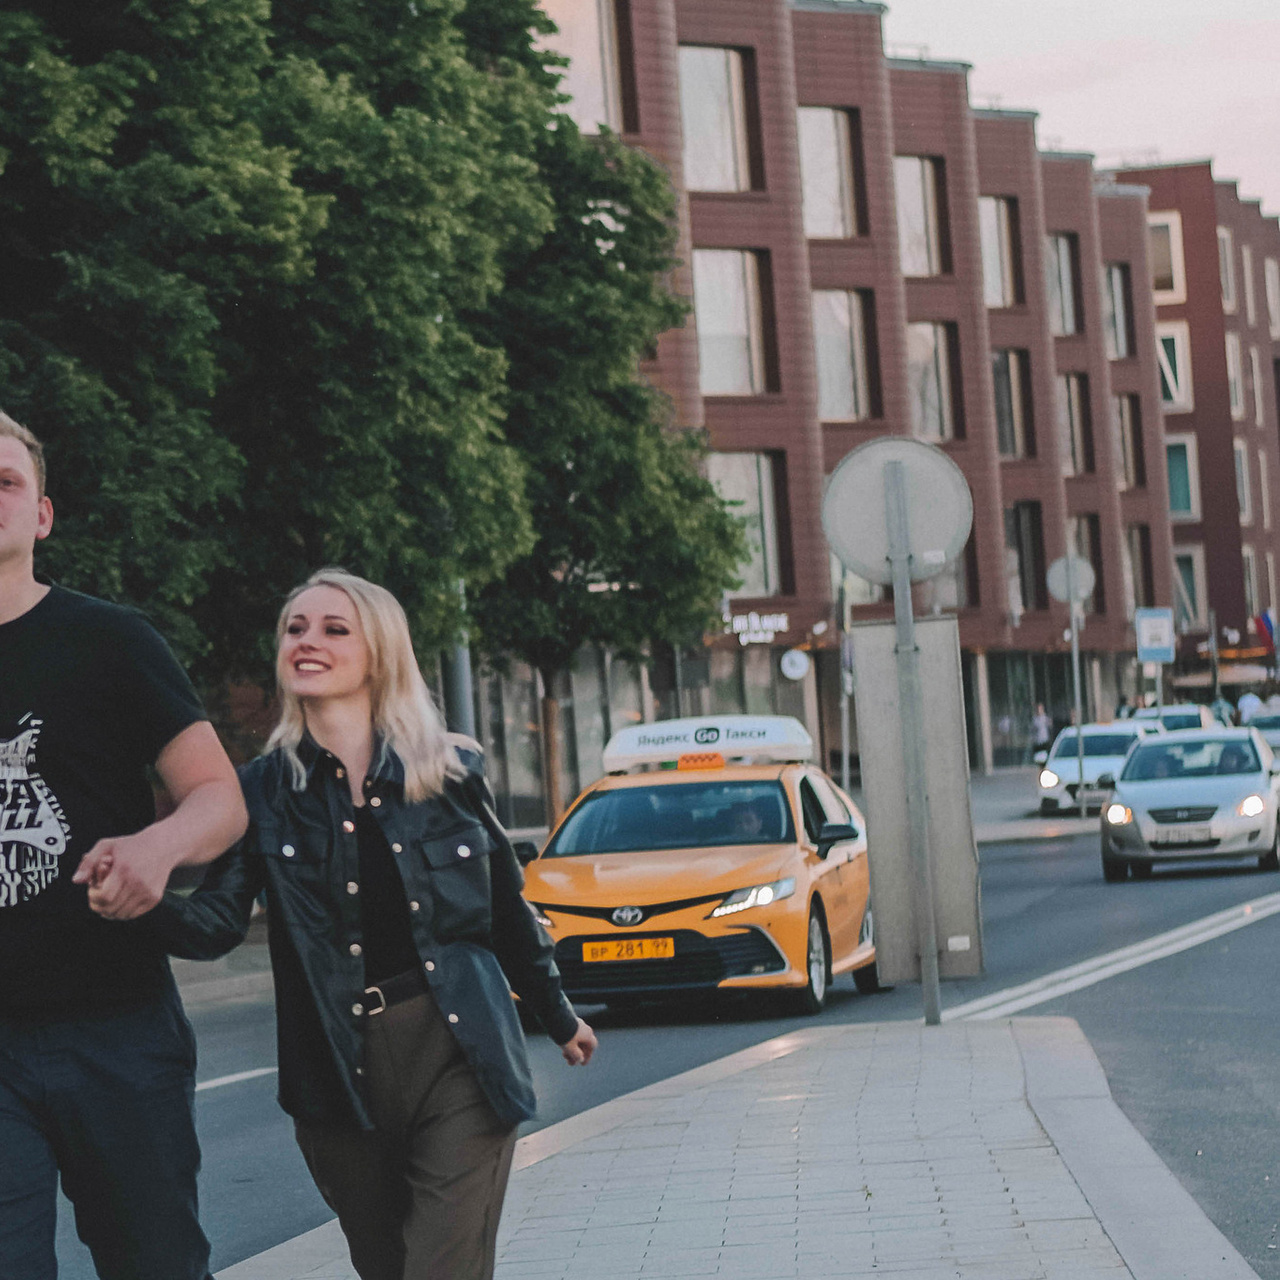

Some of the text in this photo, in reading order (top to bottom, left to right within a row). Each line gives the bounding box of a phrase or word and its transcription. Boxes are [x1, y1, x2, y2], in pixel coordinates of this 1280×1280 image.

[638, 733, 691, 747] Яндекс
[726, 728, 767, 740] Такси
[616, 942, 644, 958] 281
